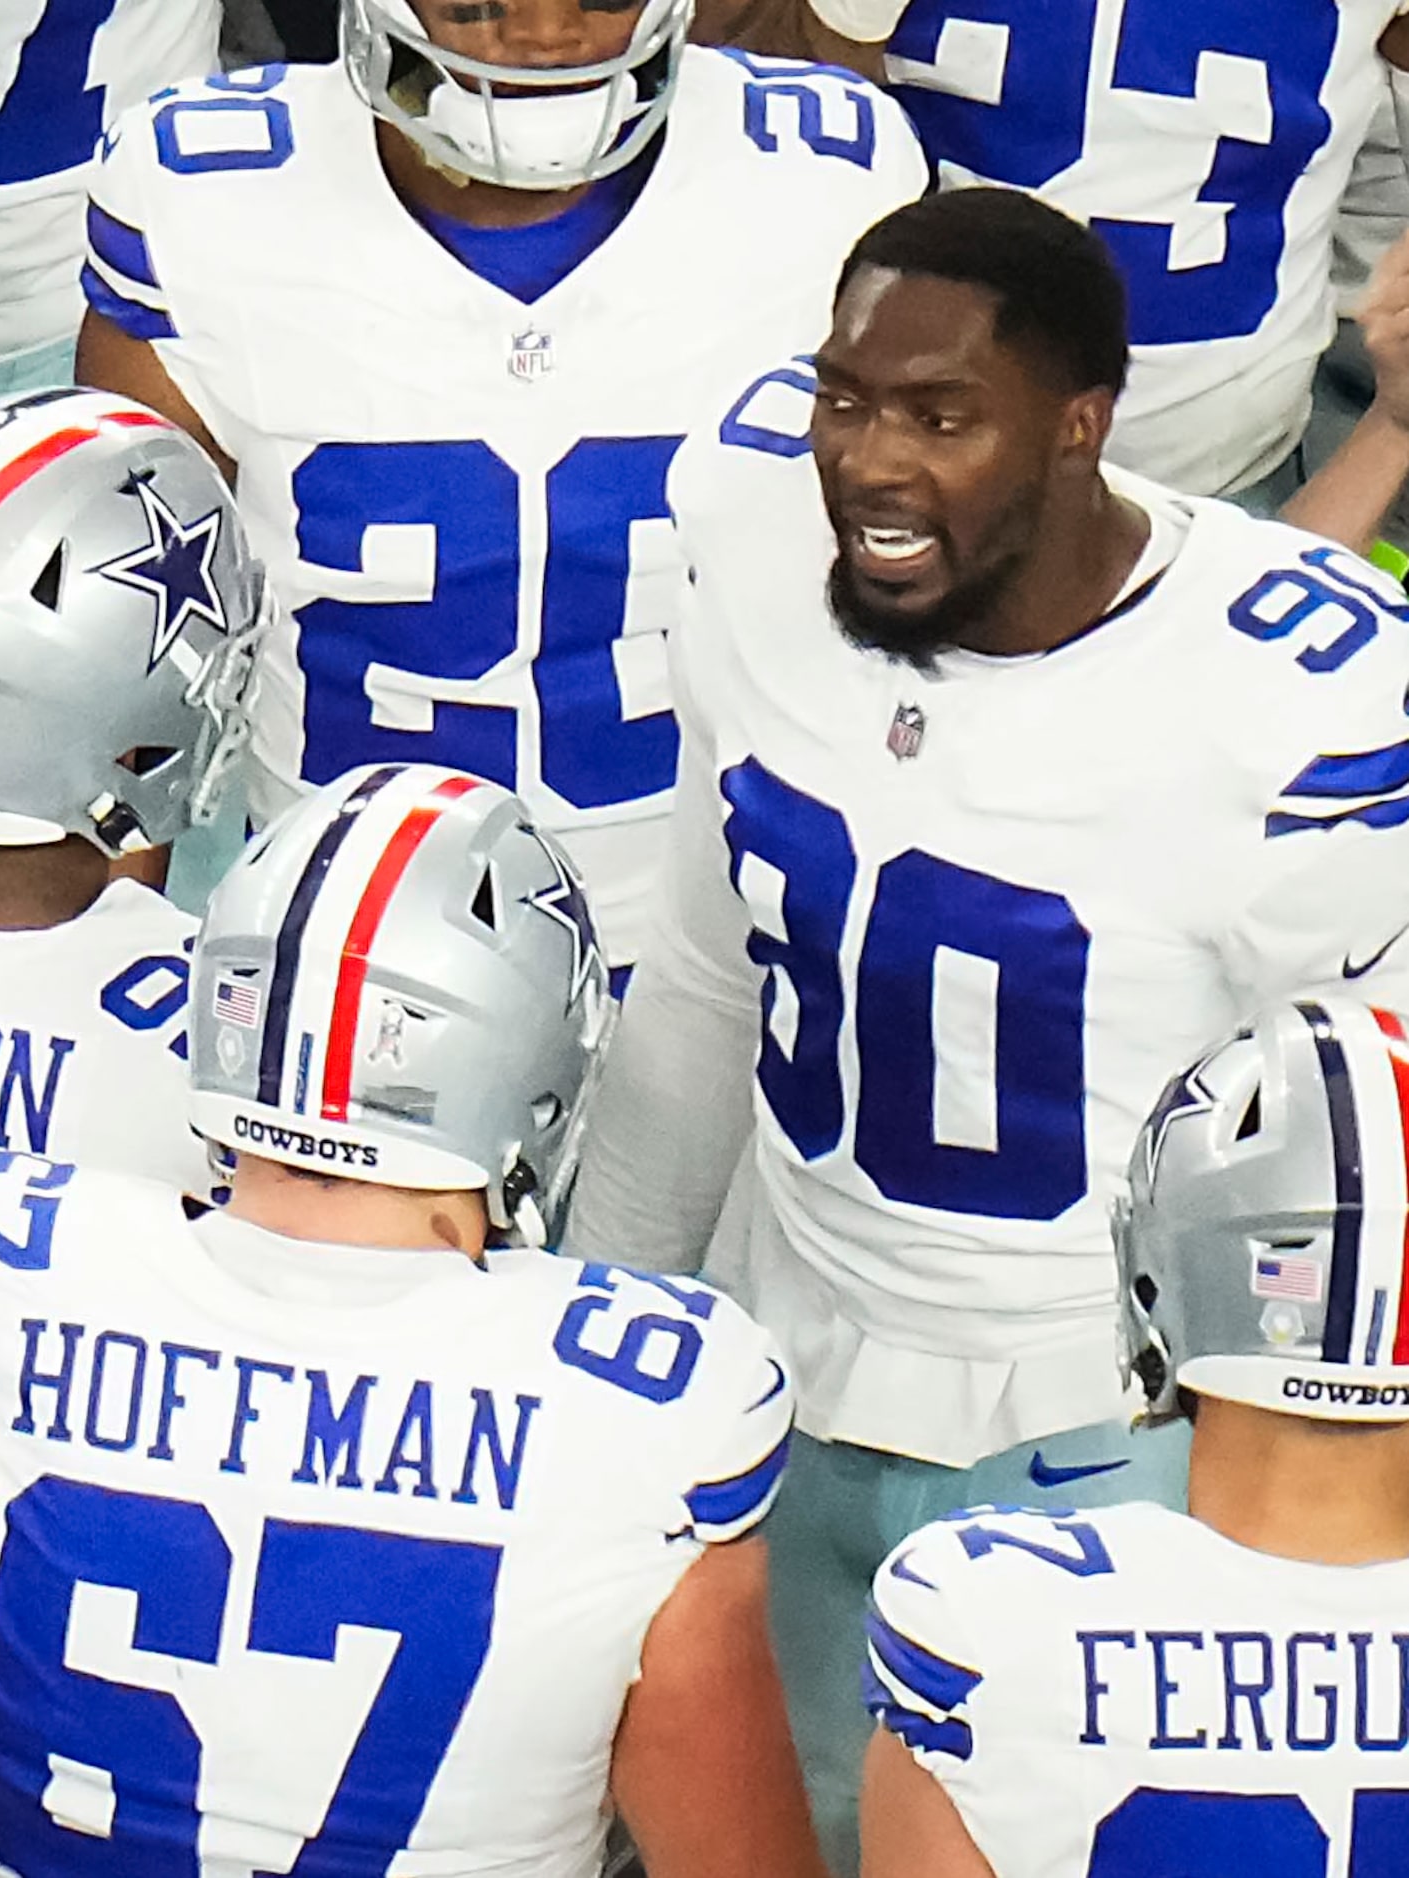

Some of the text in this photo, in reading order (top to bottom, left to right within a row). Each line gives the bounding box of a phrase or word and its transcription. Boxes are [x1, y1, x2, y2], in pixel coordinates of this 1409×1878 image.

[719, 754, 1093, 1222] 90
[233, 1115, 379, 1167] COWBOYS
[11, 1317, 543, 1511] HOFFMAN
[1075, 1630, 1409, 1752] FERGU
